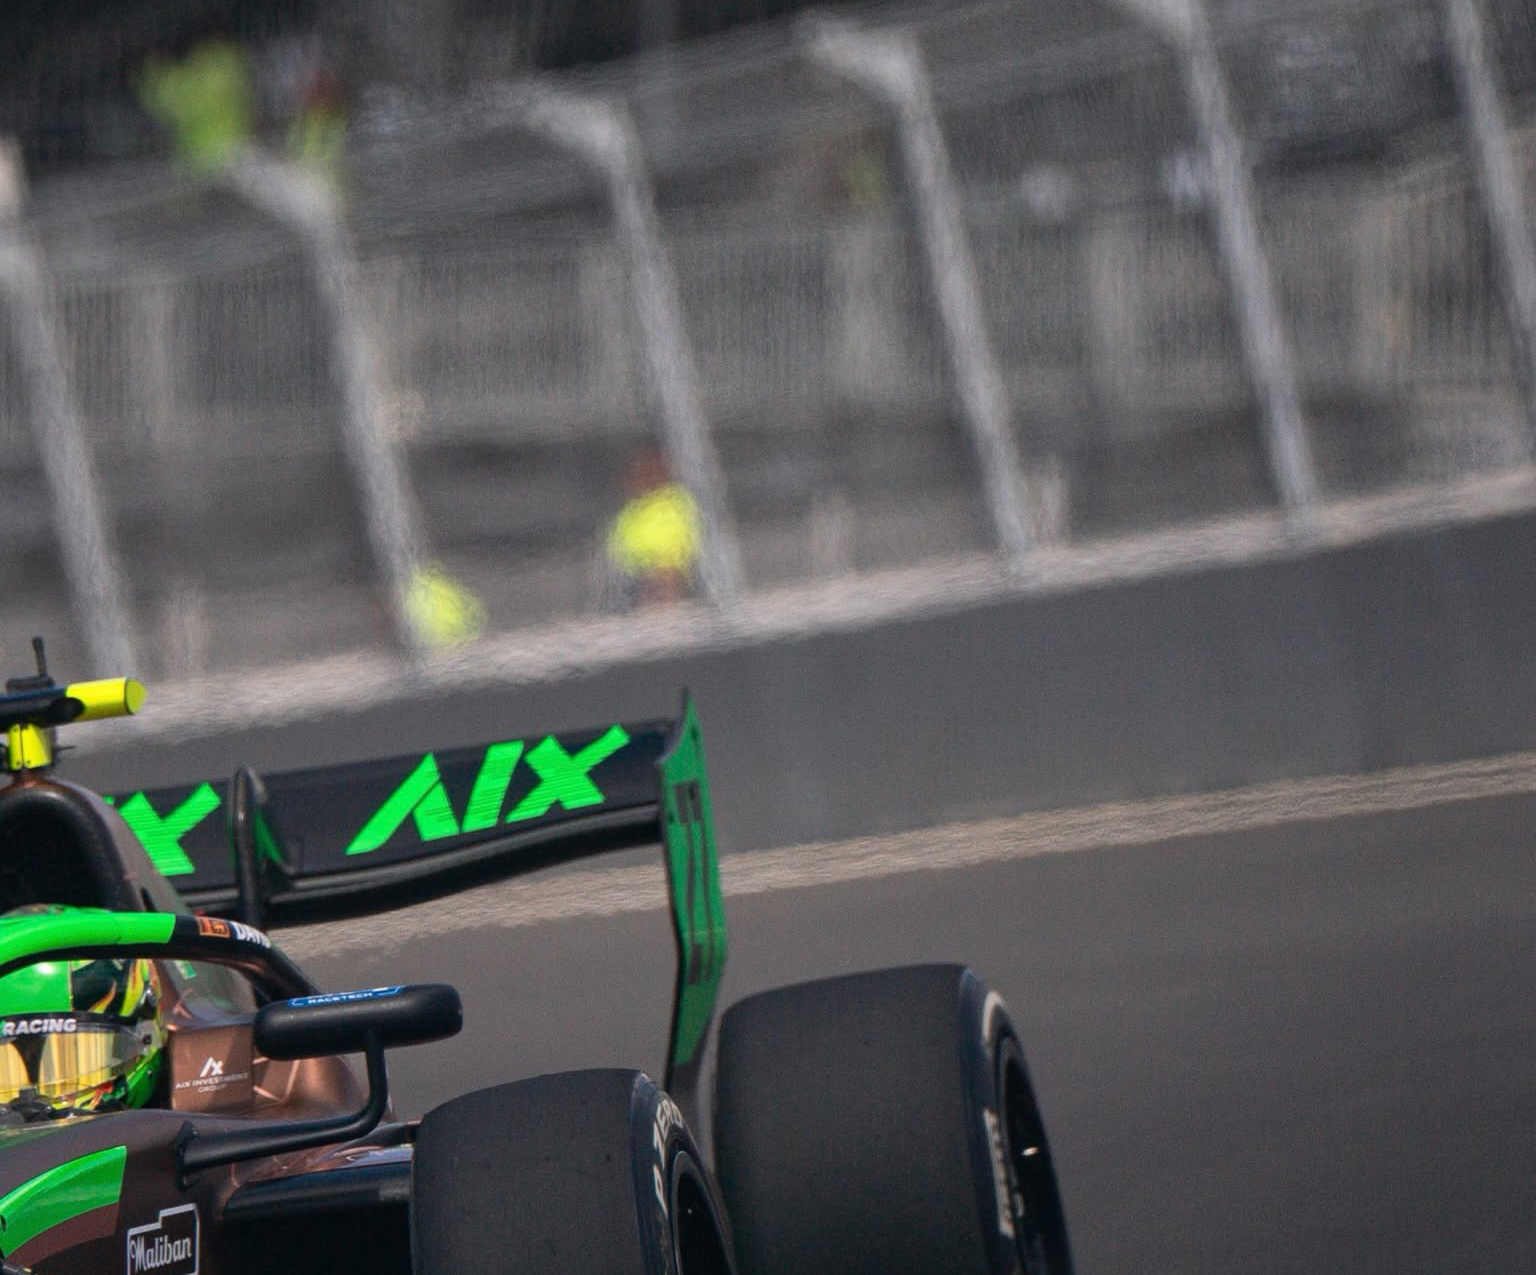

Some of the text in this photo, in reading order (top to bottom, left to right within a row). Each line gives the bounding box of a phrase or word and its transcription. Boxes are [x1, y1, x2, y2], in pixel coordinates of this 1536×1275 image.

[345, 724, 630, 842] AIX
[308, 991, 374, 1004] RACETECH
[130, 1234, 193, 1273] Maliban
